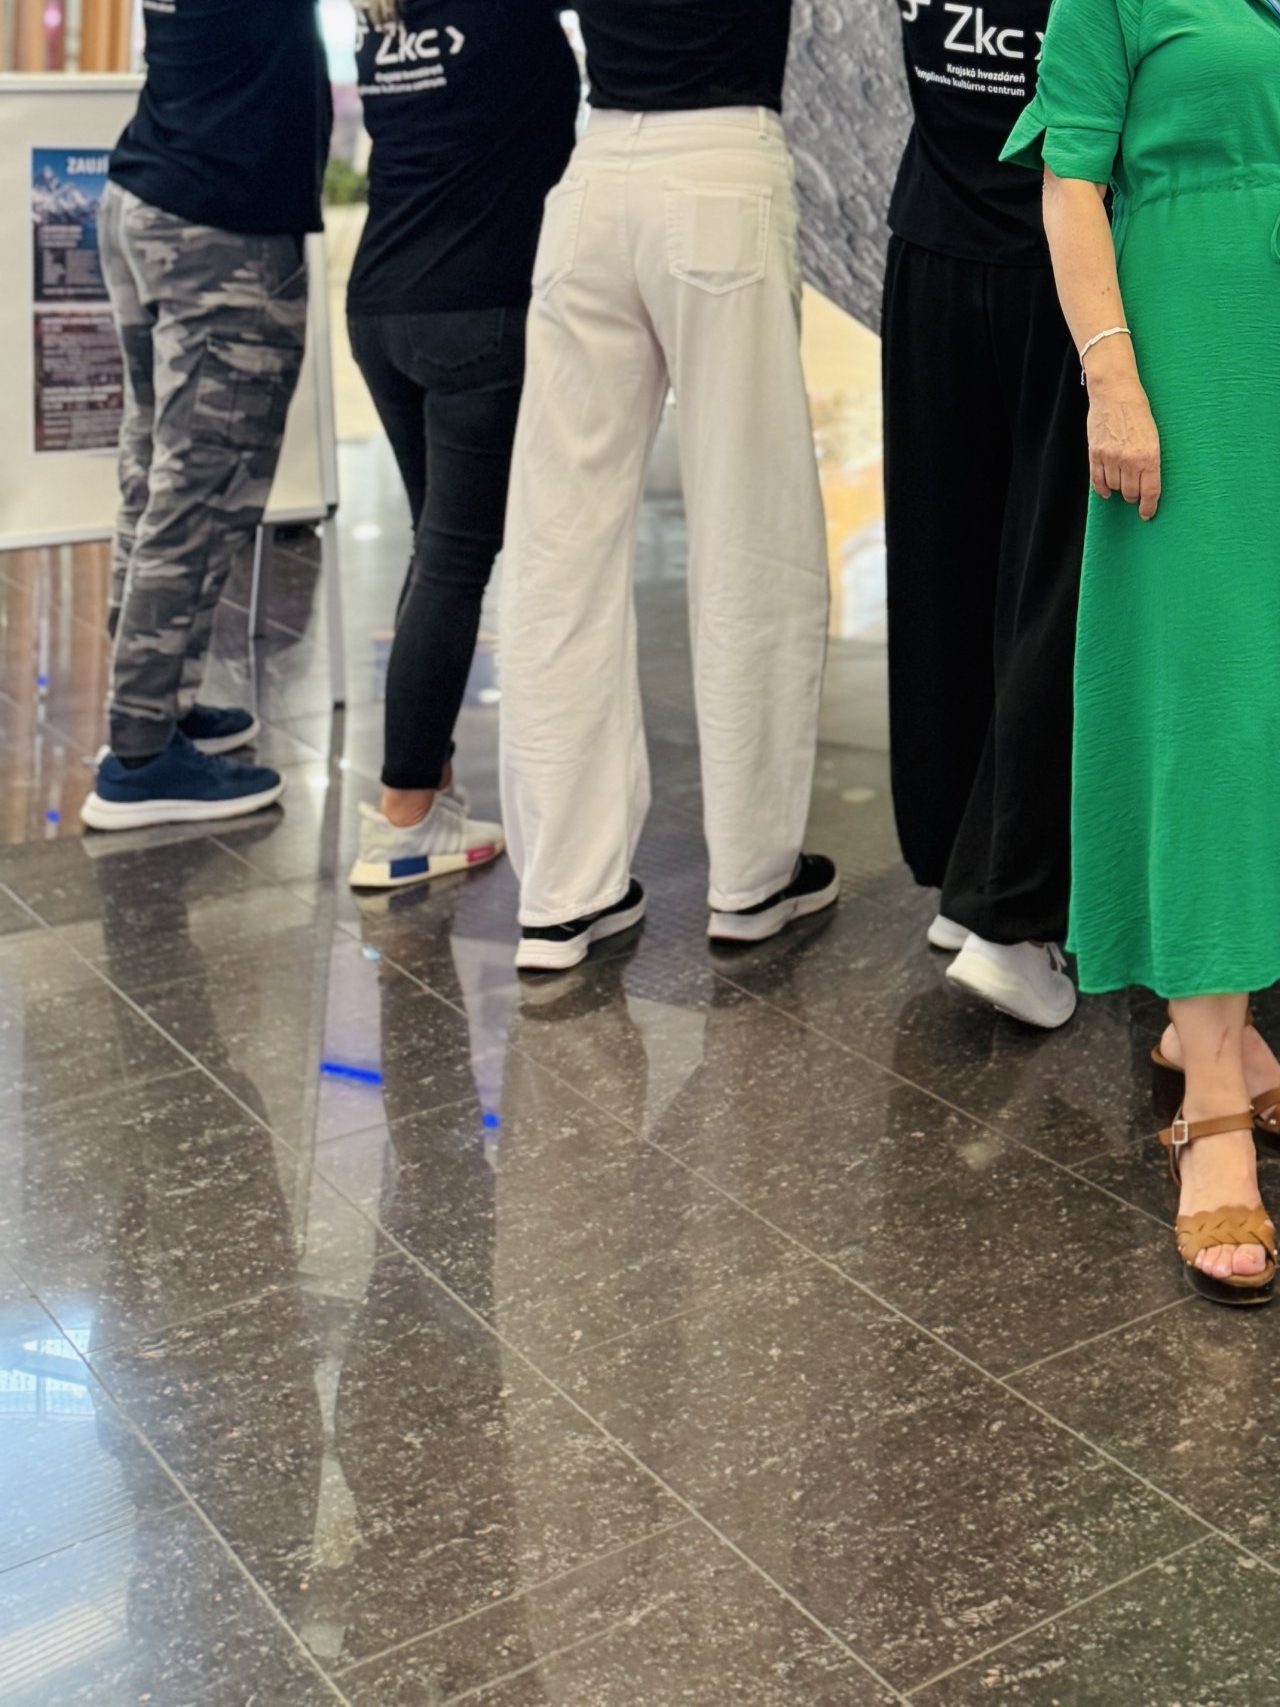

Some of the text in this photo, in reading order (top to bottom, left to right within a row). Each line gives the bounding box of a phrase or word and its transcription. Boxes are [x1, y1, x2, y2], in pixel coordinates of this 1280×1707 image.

[944, 3, 1024, 59] Zkc
[946, 63, 1026, 84] Krajská hvezdáreň
[952, 77, 986, 92] kultúrne
[987, 85, 1026, 97] centrum
